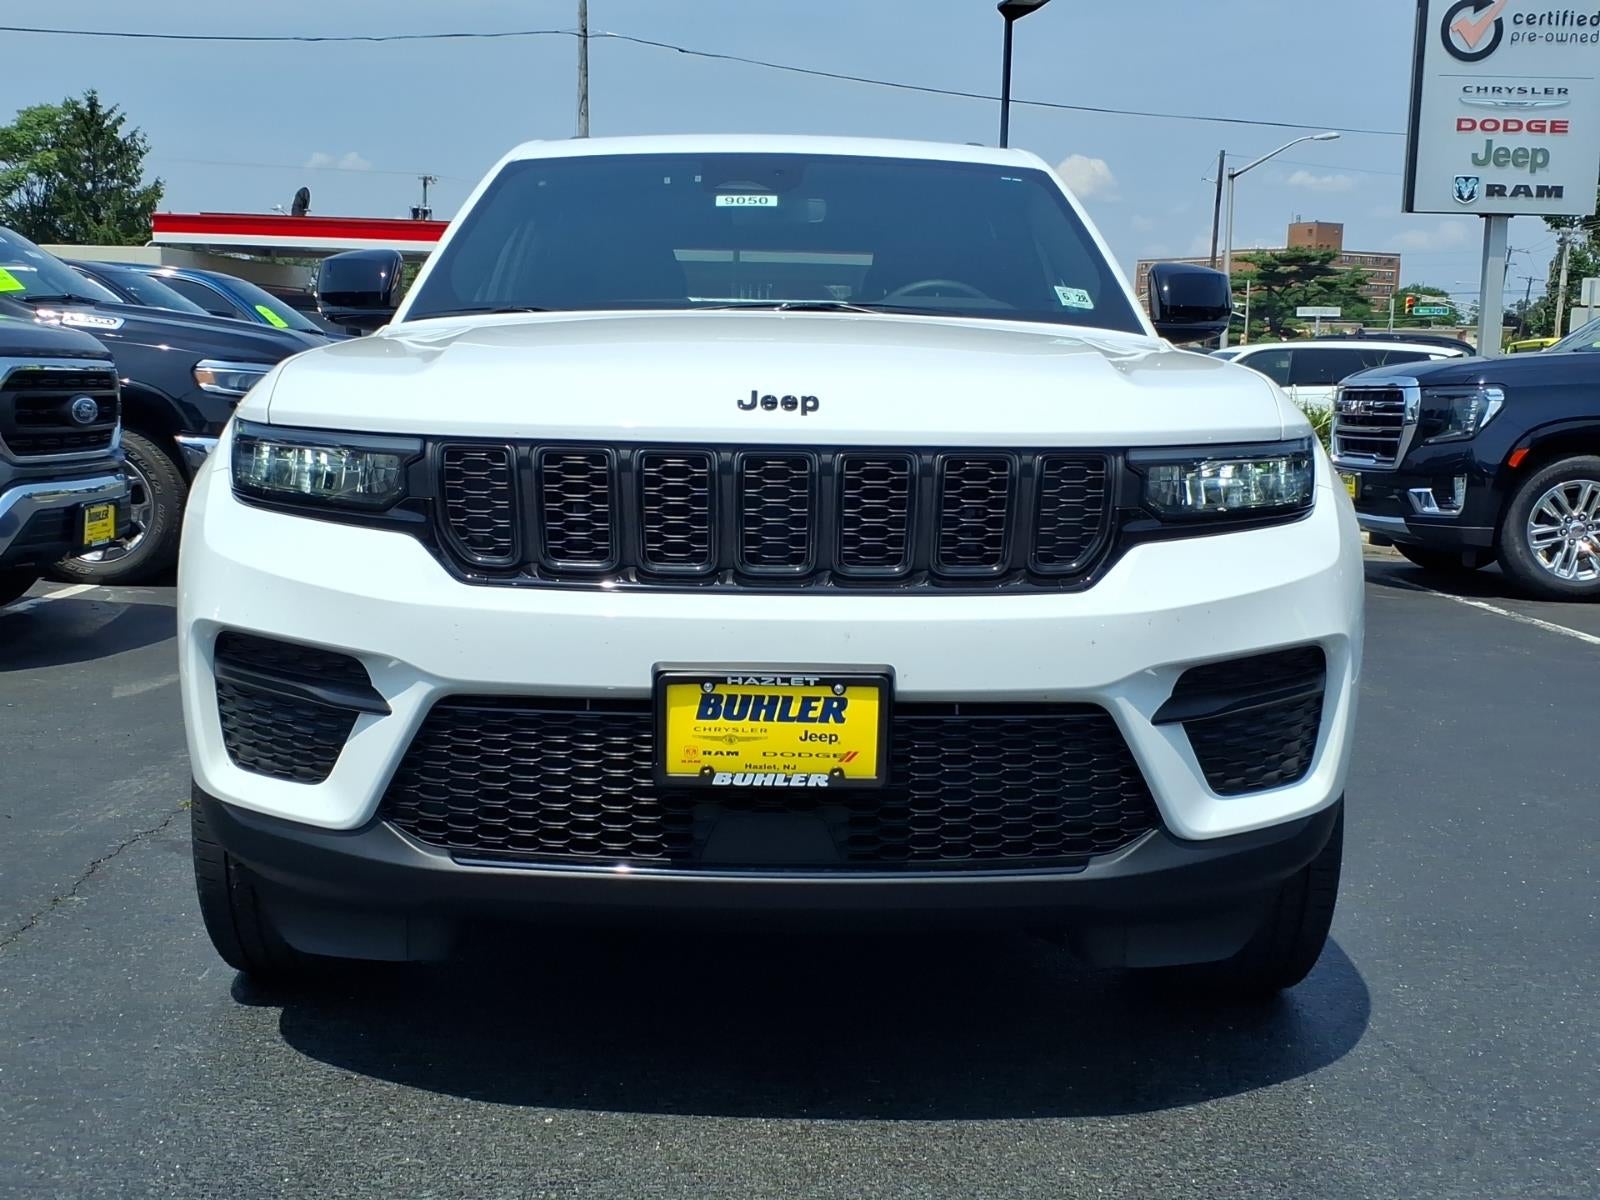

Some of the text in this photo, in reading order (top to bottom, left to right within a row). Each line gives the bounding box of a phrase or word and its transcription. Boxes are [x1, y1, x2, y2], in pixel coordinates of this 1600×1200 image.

[1513, 10, 1600, 26] certified
[1510, 30, 1600, 45] pre-owned
[1462, 85, 1569, 95] CHRYSLER
[1456, 118, 1569, 134] DODGE
[1471, 139, 1550, 174] Jeep
[1485, 184, 1564, 199] RAM
[724, 196, 769, 205] 9050
[737, 389, 820, 416] Jeep
[726, 676, 821, 686] HAZLET
[695, 692, 849, 724] BUHLER
[693, 726, 769, 734] CHRYSLER
[799, 729, 840, 745] Jeep
[762, 751, 842, 759] DODGE
[744, 763, 780, 772] Hazlet,
[712, 772, 829, 787] BUHLER
